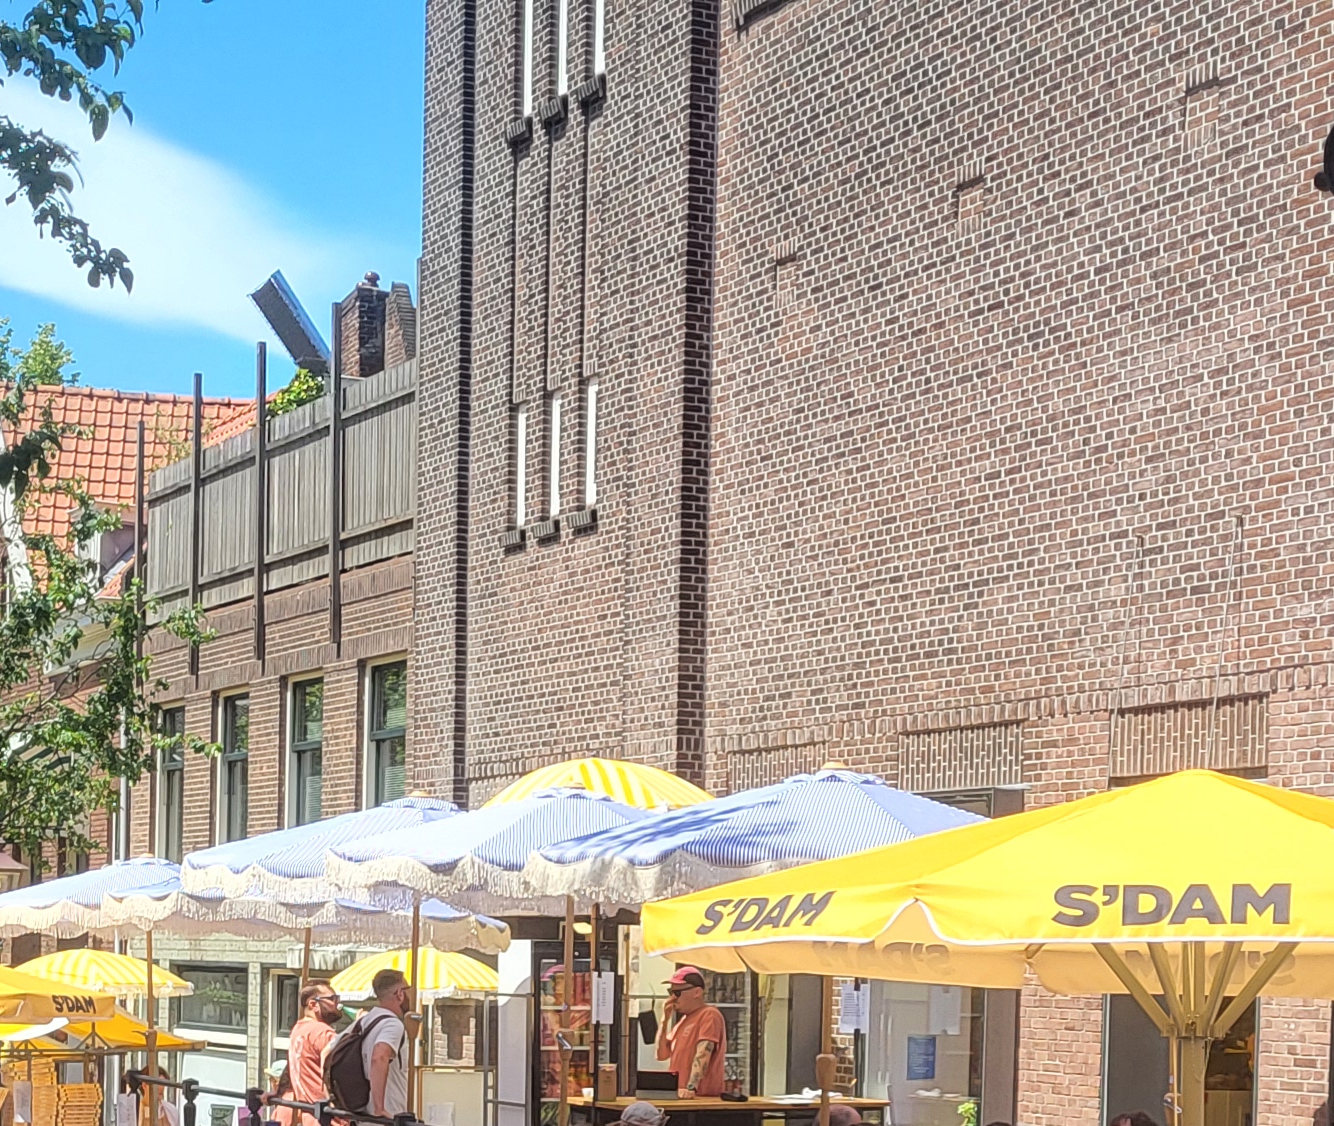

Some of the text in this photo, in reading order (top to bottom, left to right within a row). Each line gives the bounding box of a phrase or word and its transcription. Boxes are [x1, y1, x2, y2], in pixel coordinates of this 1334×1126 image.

[695, 890, 837, 935] S'DAM
[1052, 883, 1292, 927] S'DAM
[51, 995, 96, 1013] S'DAM
